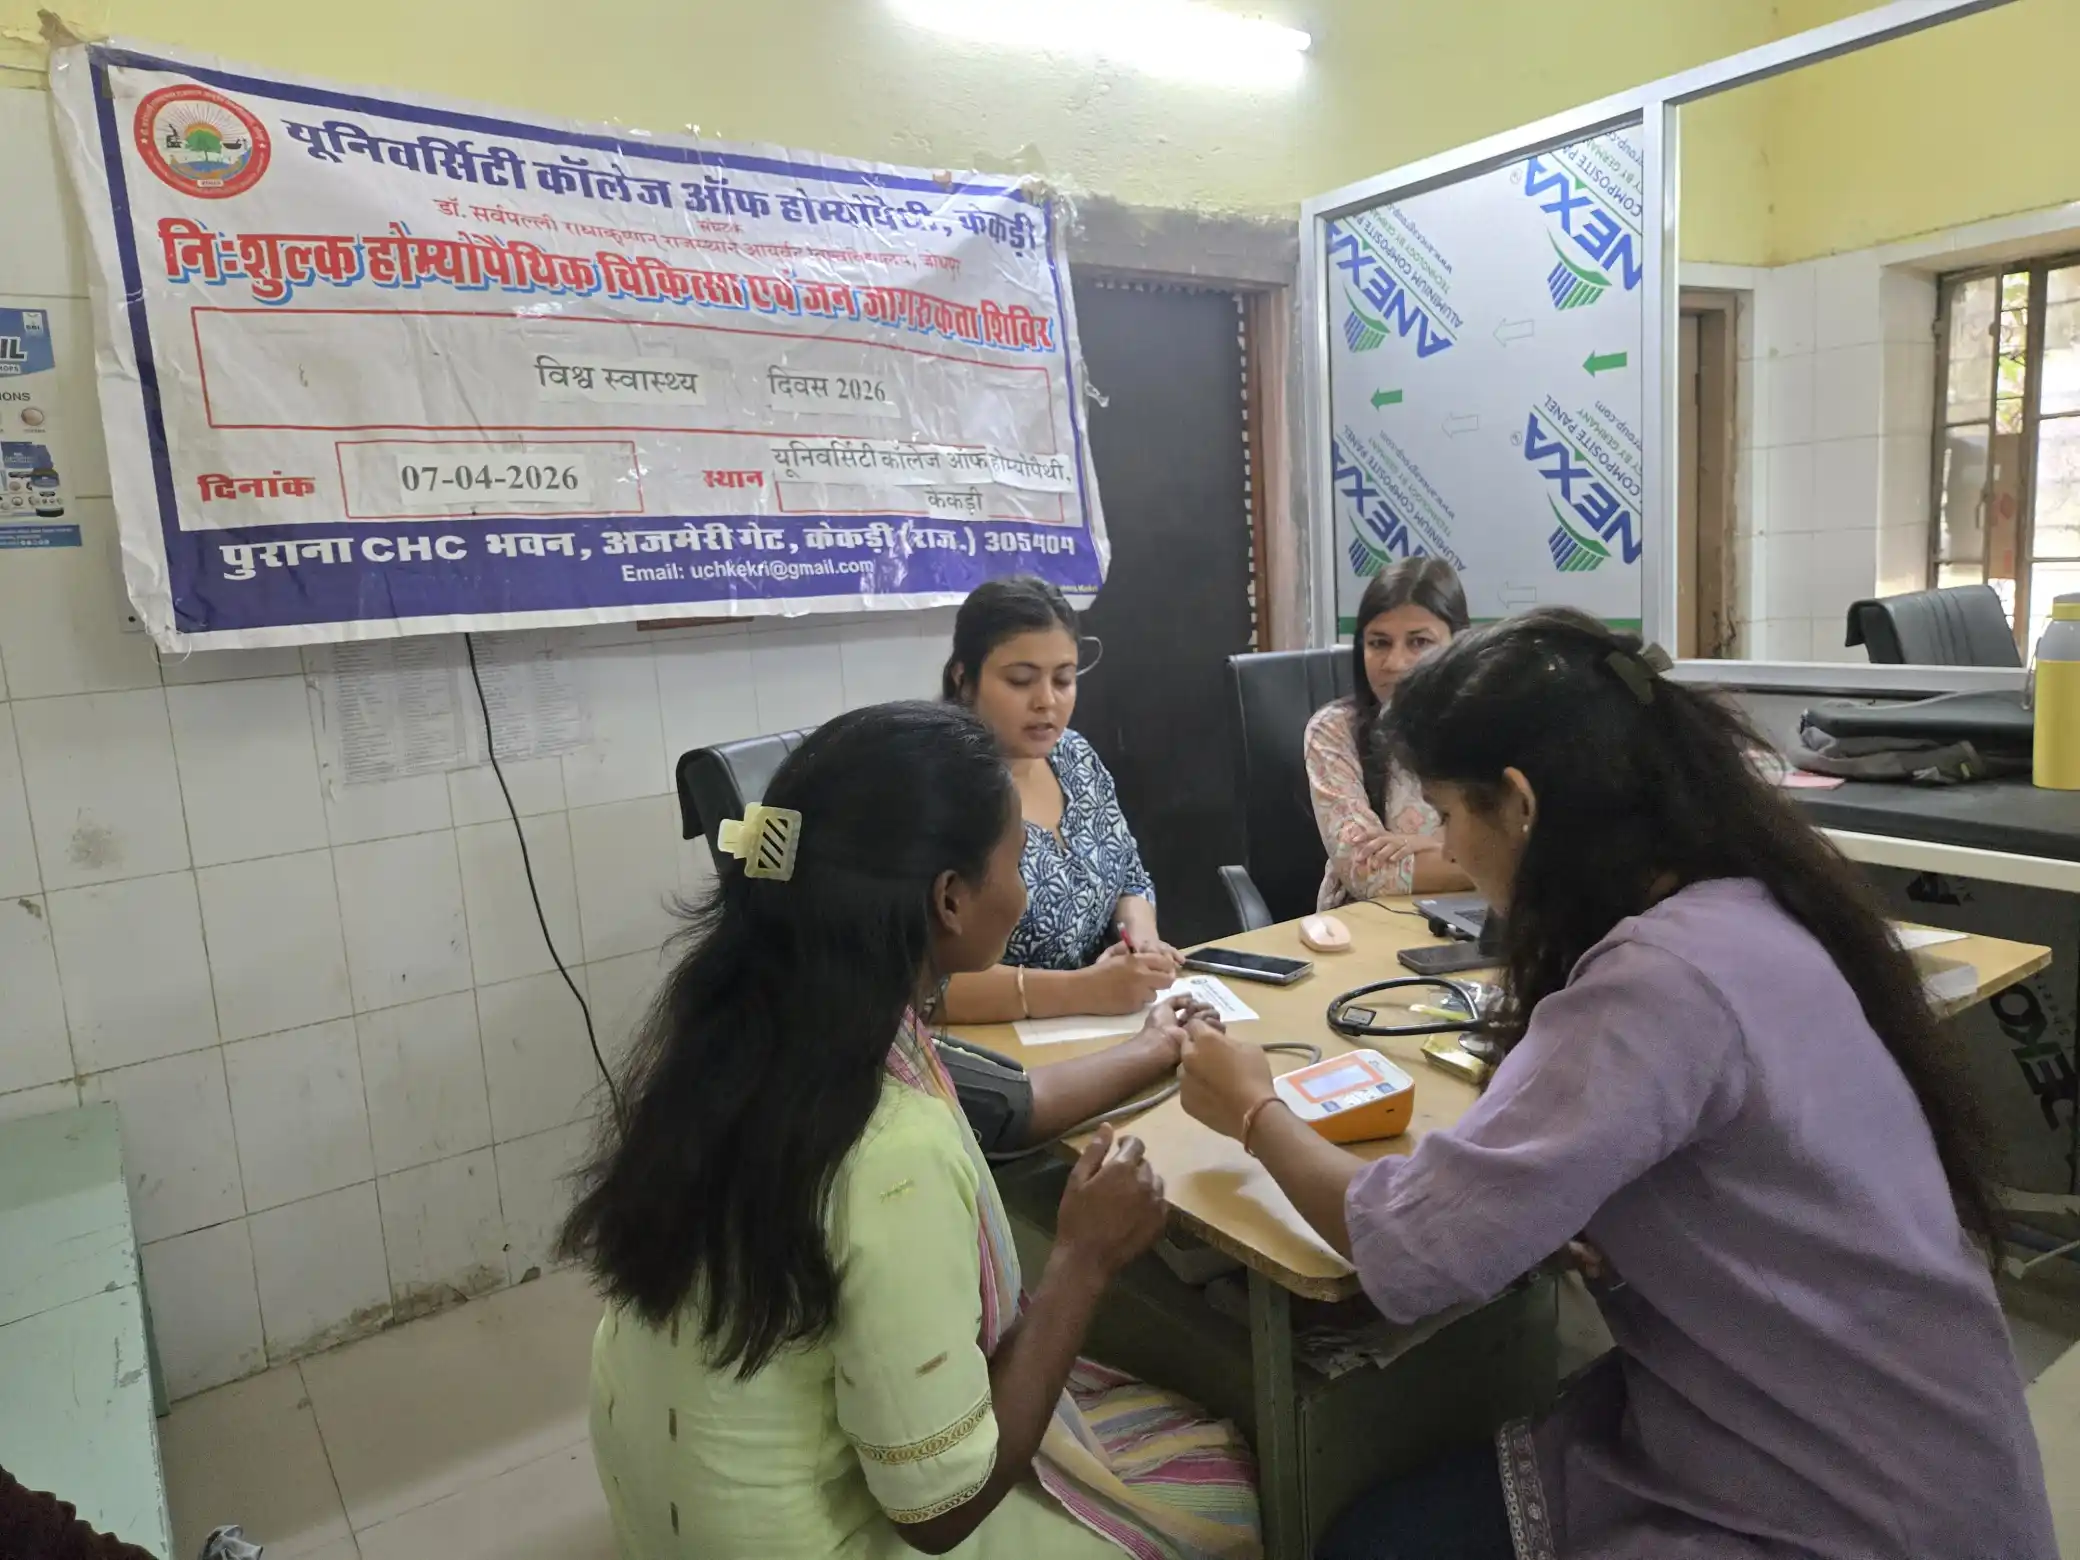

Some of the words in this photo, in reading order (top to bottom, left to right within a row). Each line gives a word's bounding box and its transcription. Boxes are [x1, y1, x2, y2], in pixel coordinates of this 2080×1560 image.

[280, 119, 527, 190] यूनिवर्सिटी
[532, 155, 673, 209] कॉलेज
[680, 175, 771, 219] ऑफ
[953, 203, 1037, 257] केकड़ी
[433, 197, 467, 218] डॉ.
[362, 221, 600, 296] होम्योपैथिक
[596, 251, 749, 310] चिकित्सा
[745, 268, 800, 315] एवं
[799, 280, 859, 321] जन
[981, 300, 1055, 352] शिविर
[1411, 274, 1463, 328] ALUMINIUM
[534, 355, 595, 389] विश्व
[601, 367, 698, 394] स्वास्थ्य
[767, 364, 829, 398] दिवस
[836, 377, 886, 402] 2026
[1545, 394, 1578, 434] PANEL
[771, 440, 877, 478] यूनिवर्सिटी
[876, 439, 941, 470] कॉलेज
[947, 446, 987, 470] ऑफ
[1576, 428, 1641, 497] COMPOSITE
[197, 470, 316, 501] दिनांक
[401, 464, 580, 491] 07-04-2026
[703, 469, 765, 489] स्थान
[925, 486, 982, 514] केकड़ी
[219, 536, 354, 581] पुराना
[361, 535, 468, 562] CHC
[486, 531, 592, 561] भवन,
[601, 522, 733, 555] अजमेरी
[736, 523, 799, 554] गेट,
[803, 521, 895, 554] केकड़ी
[984, 531, 1076, 556] 305404
[621, 563, 684, 582] Email:
[689, 557, 874, 581] uchkekri@gmail.com
